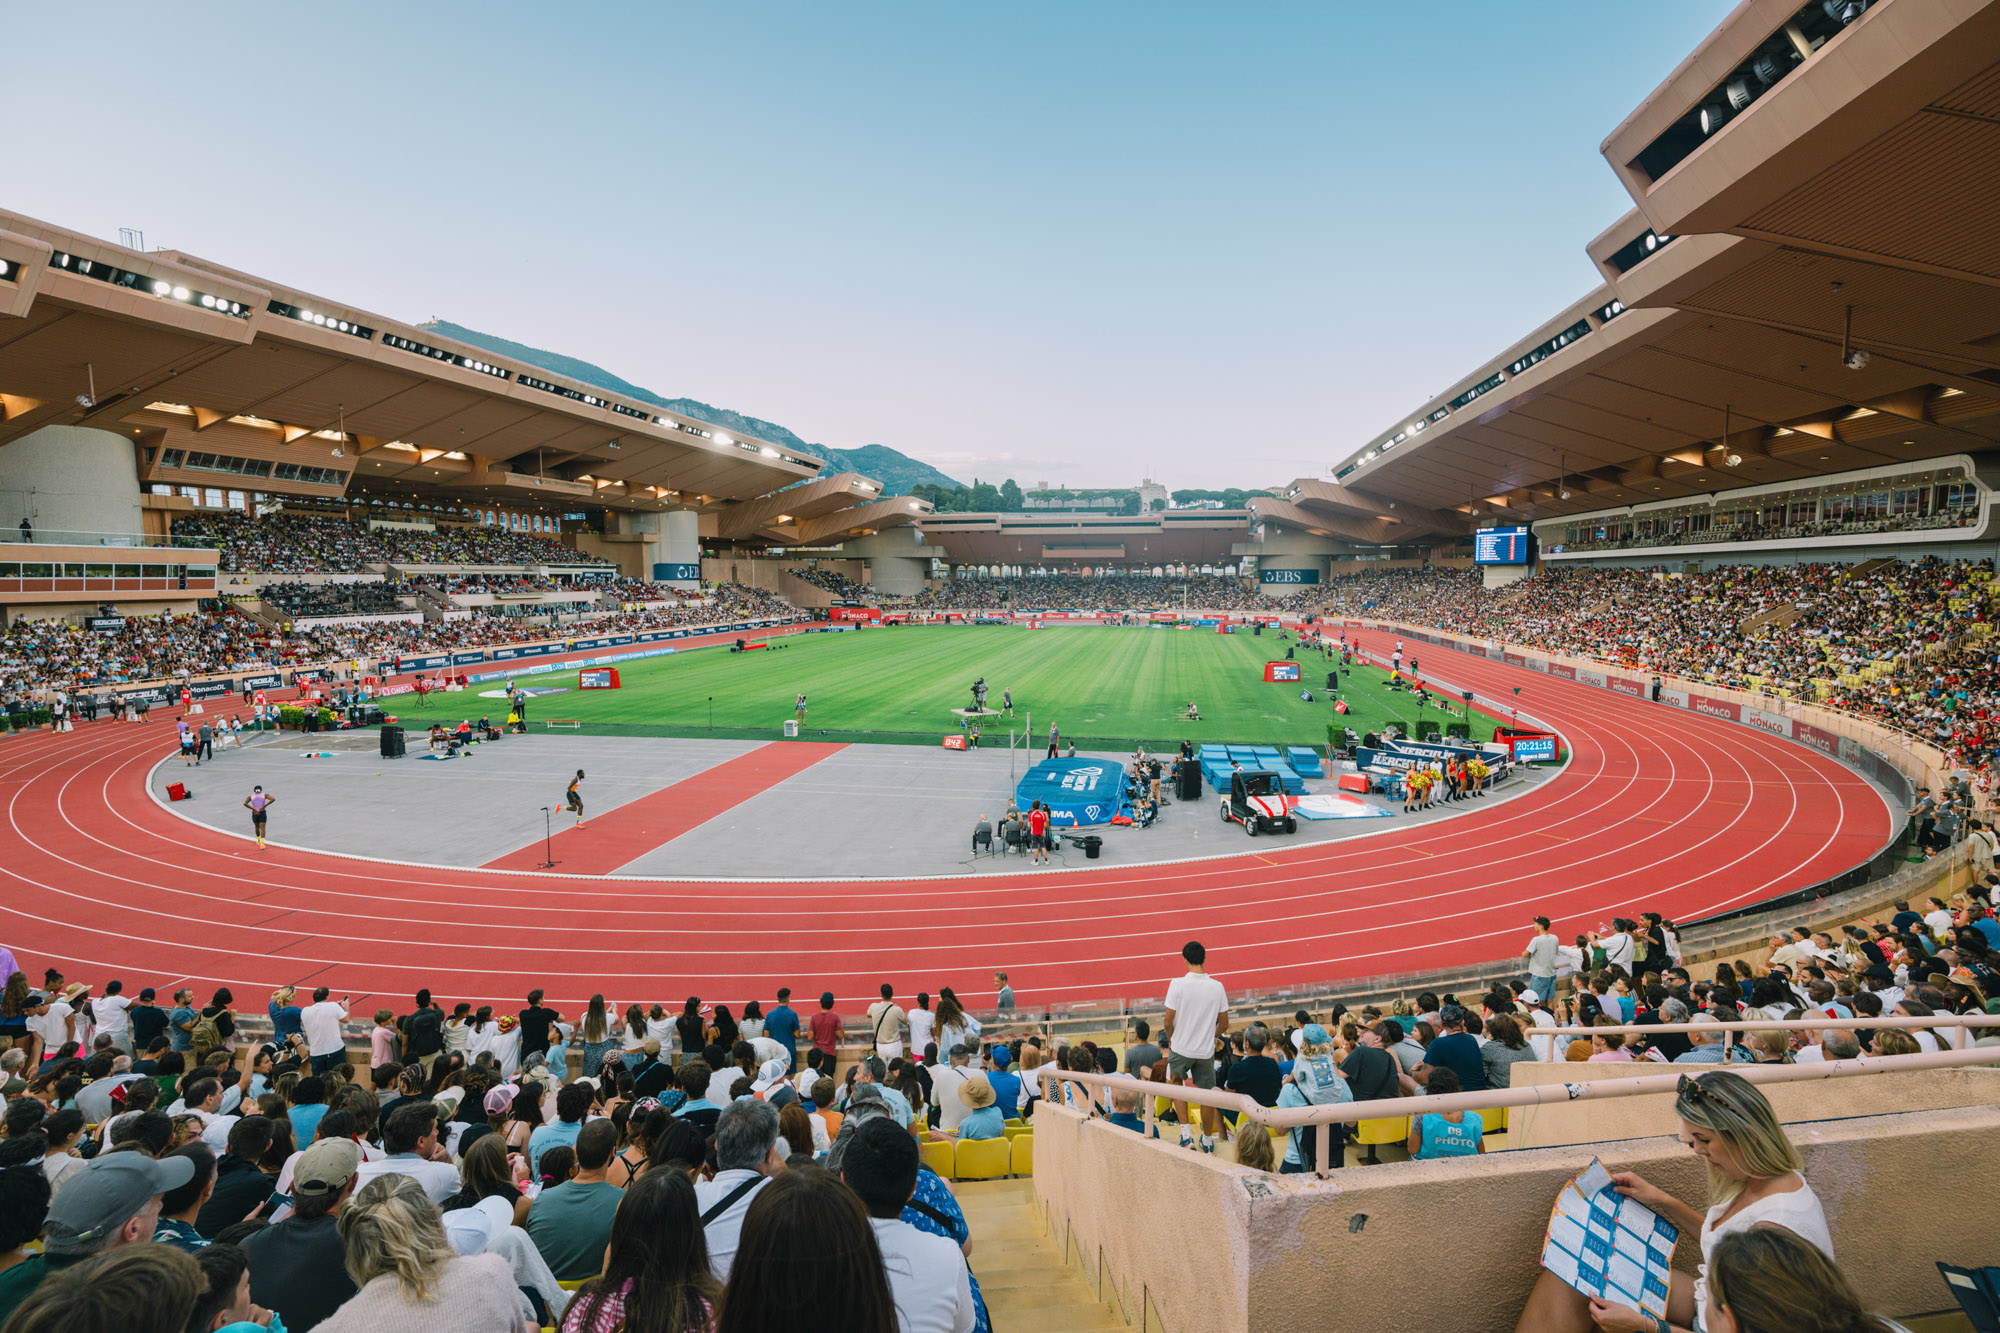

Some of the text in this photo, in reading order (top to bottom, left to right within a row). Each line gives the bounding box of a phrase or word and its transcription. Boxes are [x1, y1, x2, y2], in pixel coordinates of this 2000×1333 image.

[688, 566, 699, 578] EB
[1275, 571, 1301, 582] EBS
[1552, 668, 1570, 678] MONACO
[1580, 676, 1600, 686] MONACO
[390, 684, 415, 694] OMEGA
[1613, 684, 1638, 694] MONACO
[1658, 694, 1680, 706] ONACO
[1696, 702, 1730, 718] MONACO
[1750, 716, 1783, 734] MONACO
[1516, 741, 1552, 750] 20:21:15
[1800, 732, 1830, 751] MONACO
[1051, 810, 1074, 818] IMA
[1435, 1136, 1475, 1148] PHOTO
